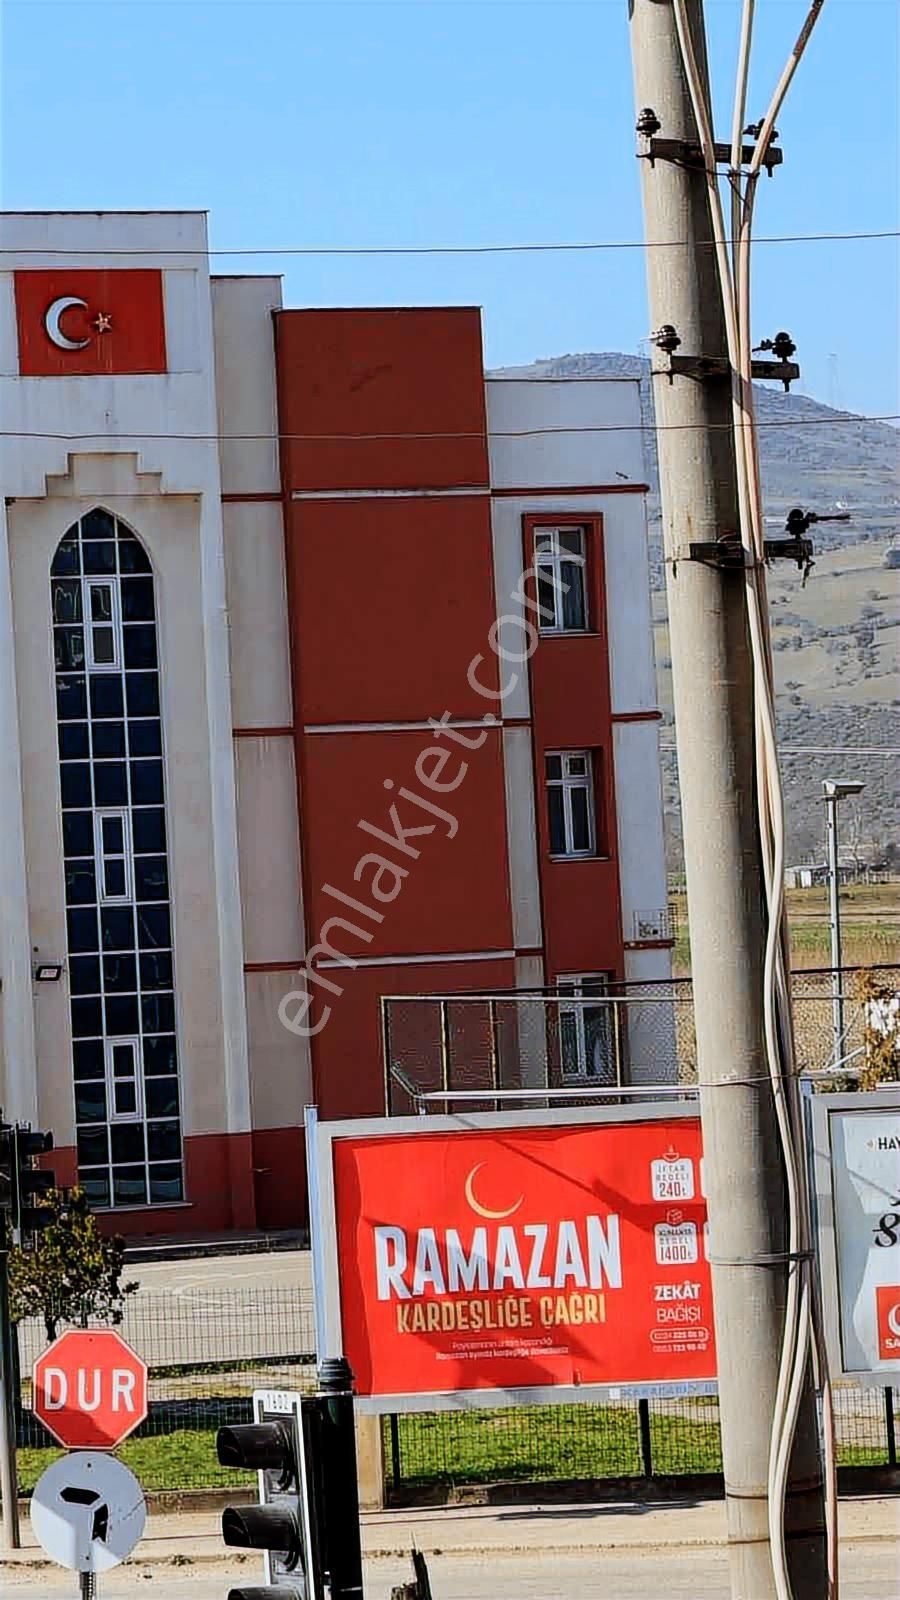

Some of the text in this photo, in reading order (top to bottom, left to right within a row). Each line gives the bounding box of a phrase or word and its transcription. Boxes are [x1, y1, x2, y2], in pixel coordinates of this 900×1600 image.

[374, 1214, 622, 1300] RAMAZAN
[397, 1291, 606, 1333] KARDEŞLİĞE ÇAĞRI
[654, 1280, 701, 1301] ZEKÂT
[44, 1367, 136, 1412] DUR
